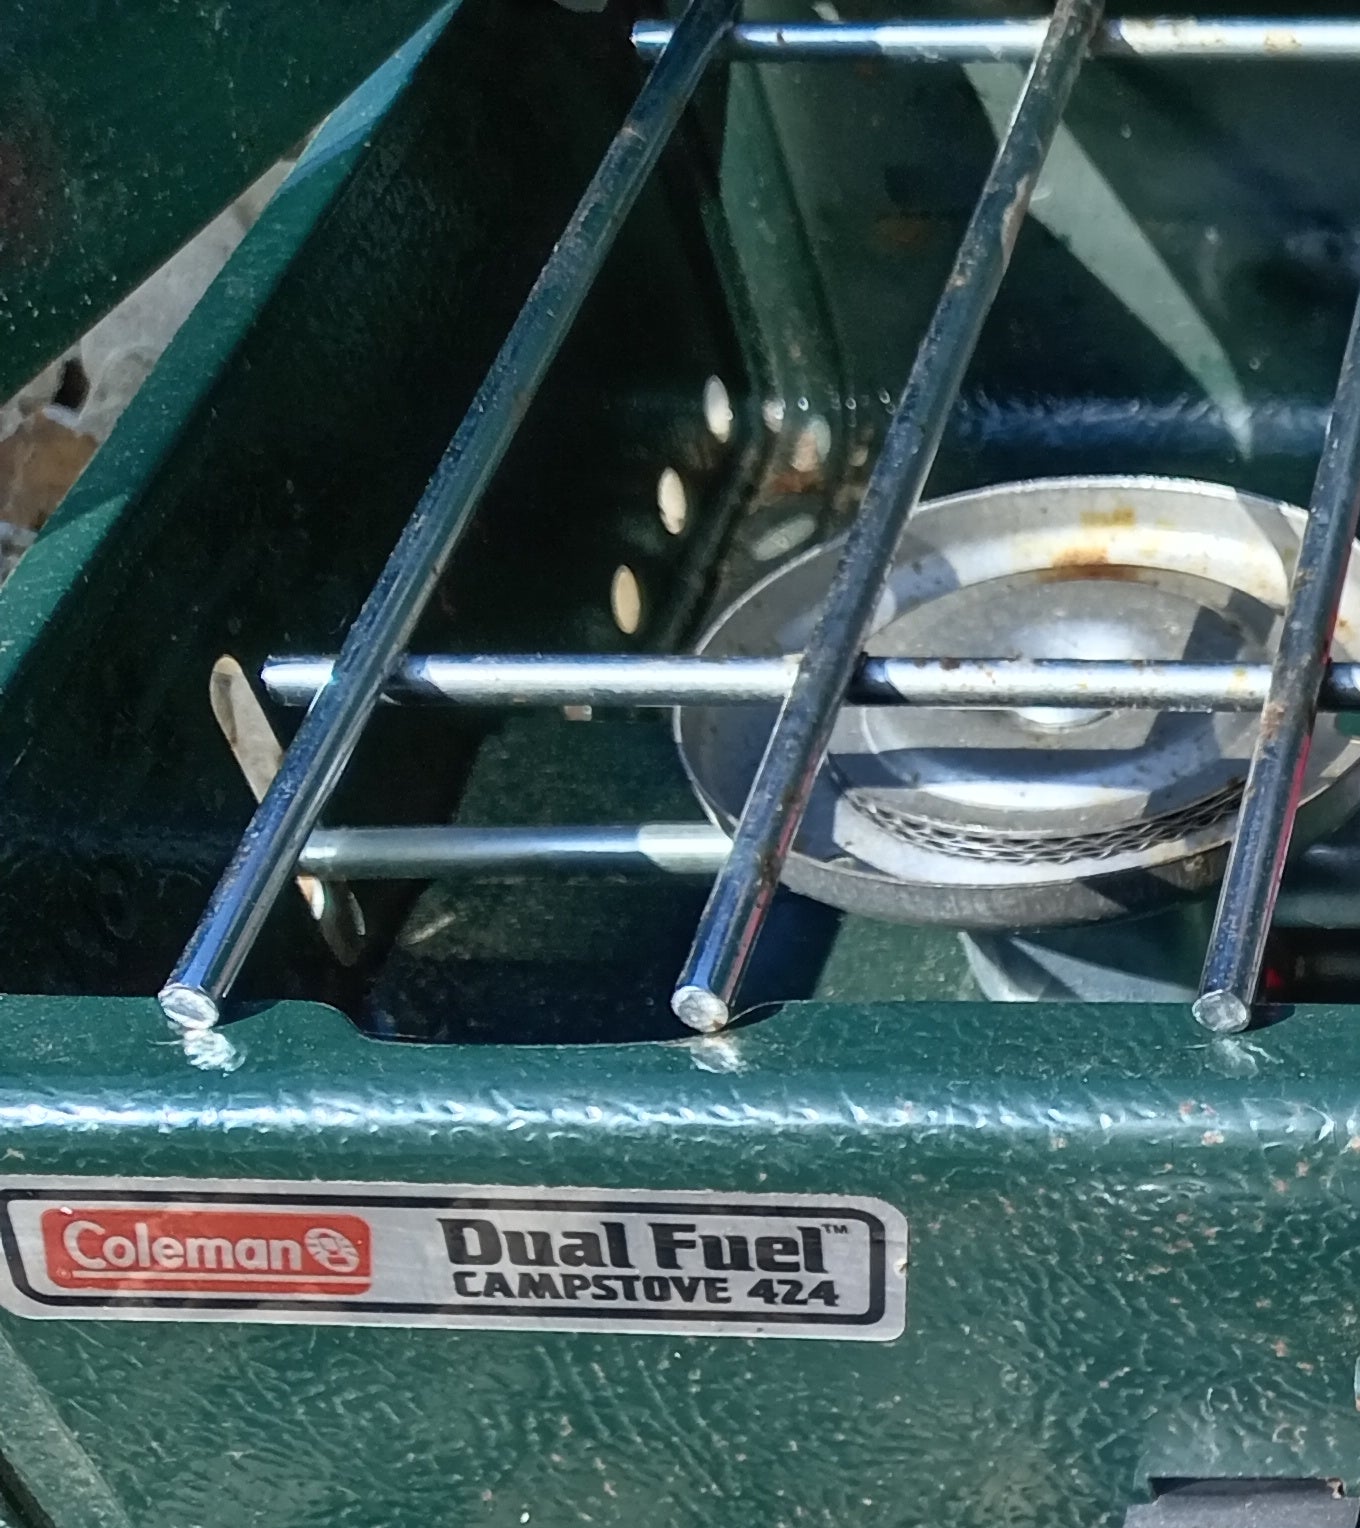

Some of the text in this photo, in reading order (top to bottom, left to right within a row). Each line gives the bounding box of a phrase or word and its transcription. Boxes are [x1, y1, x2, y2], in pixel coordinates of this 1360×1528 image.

[62, 1219, 302, 1271] Coleman
[436, 1217, 636, 1270] Dual
[453, 1270, 840, 1307] CAMPSTOVE 424
